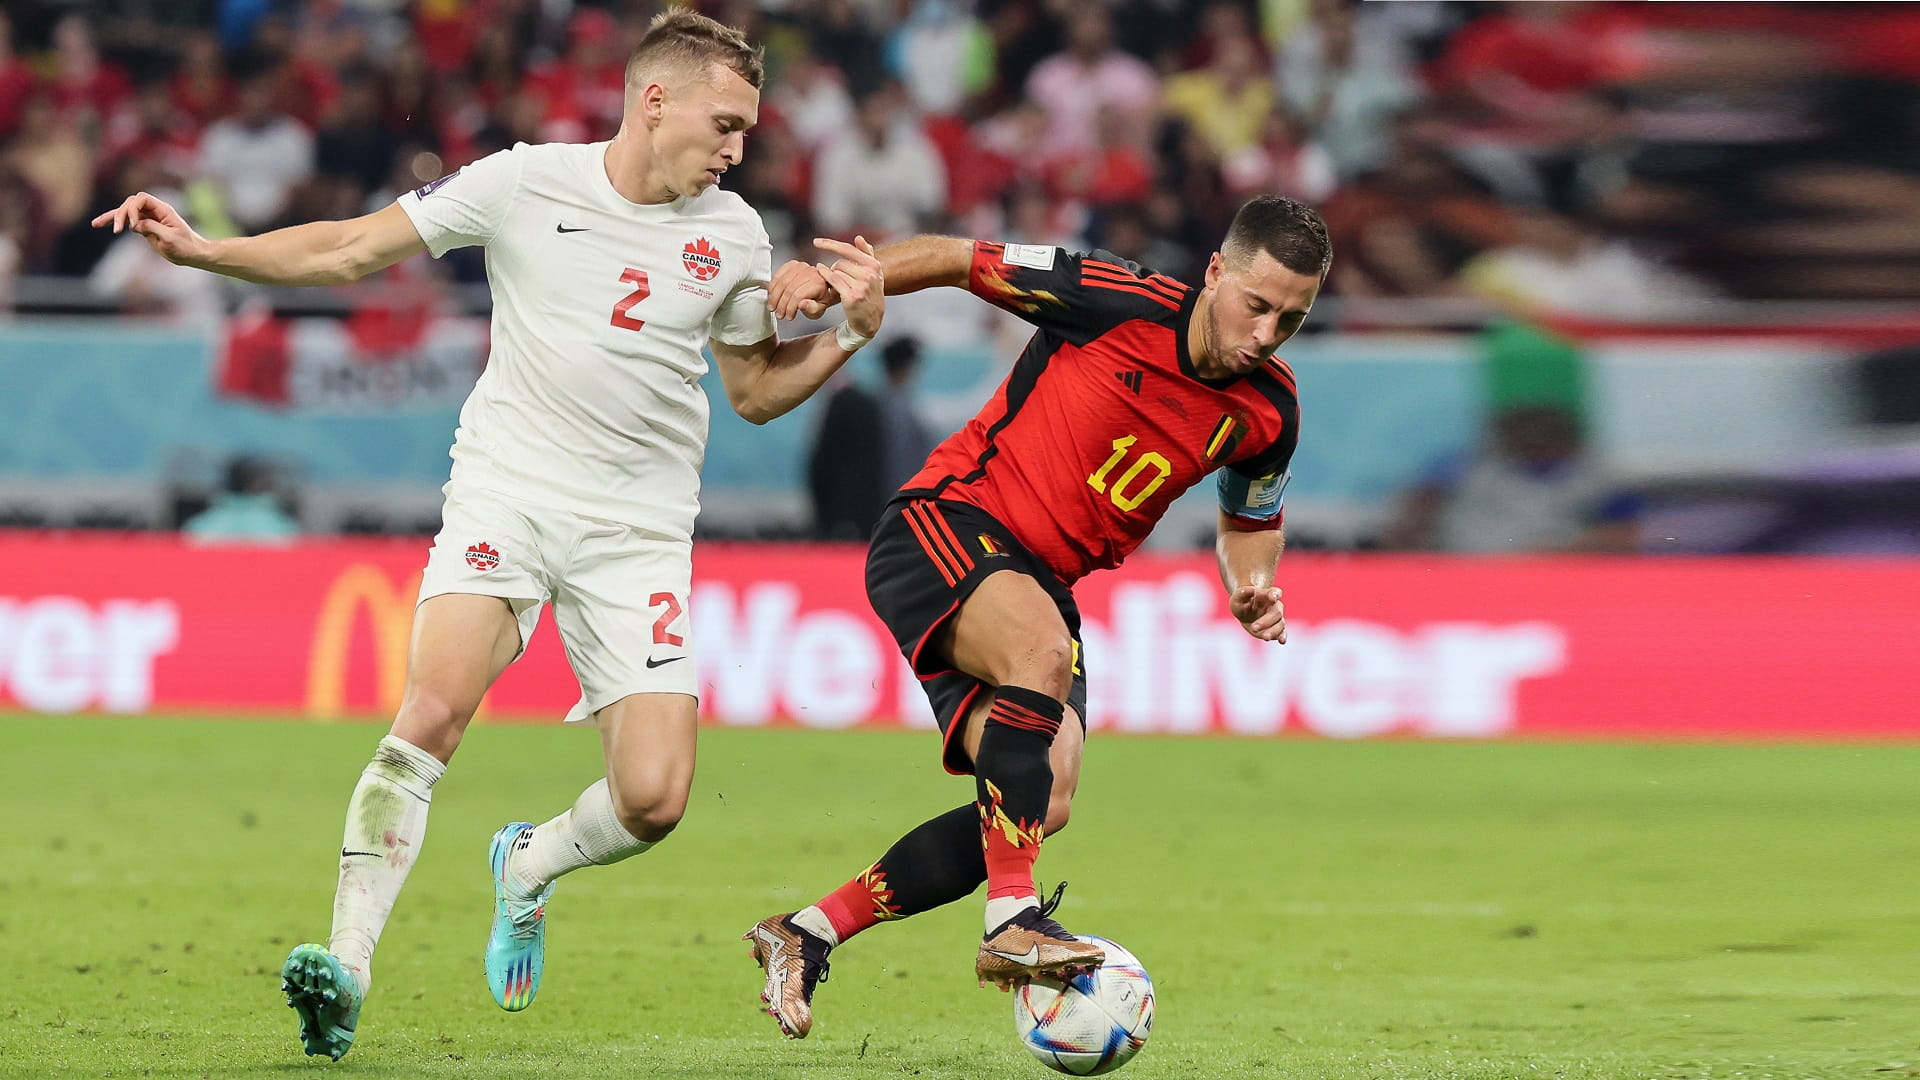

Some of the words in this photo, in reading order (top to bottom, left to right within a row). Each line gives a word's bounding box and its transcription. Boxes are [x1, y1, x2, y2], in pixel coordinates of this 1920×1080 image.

[682, 253, 721, 267] CANADA
[610, 267, 650, 331] 2
[1086, 434, 1171, 512] 10
[465, 552, 500, 563] CANADA
[649, 592, 683, 647] 2
[0, 597, 180, 714] er
